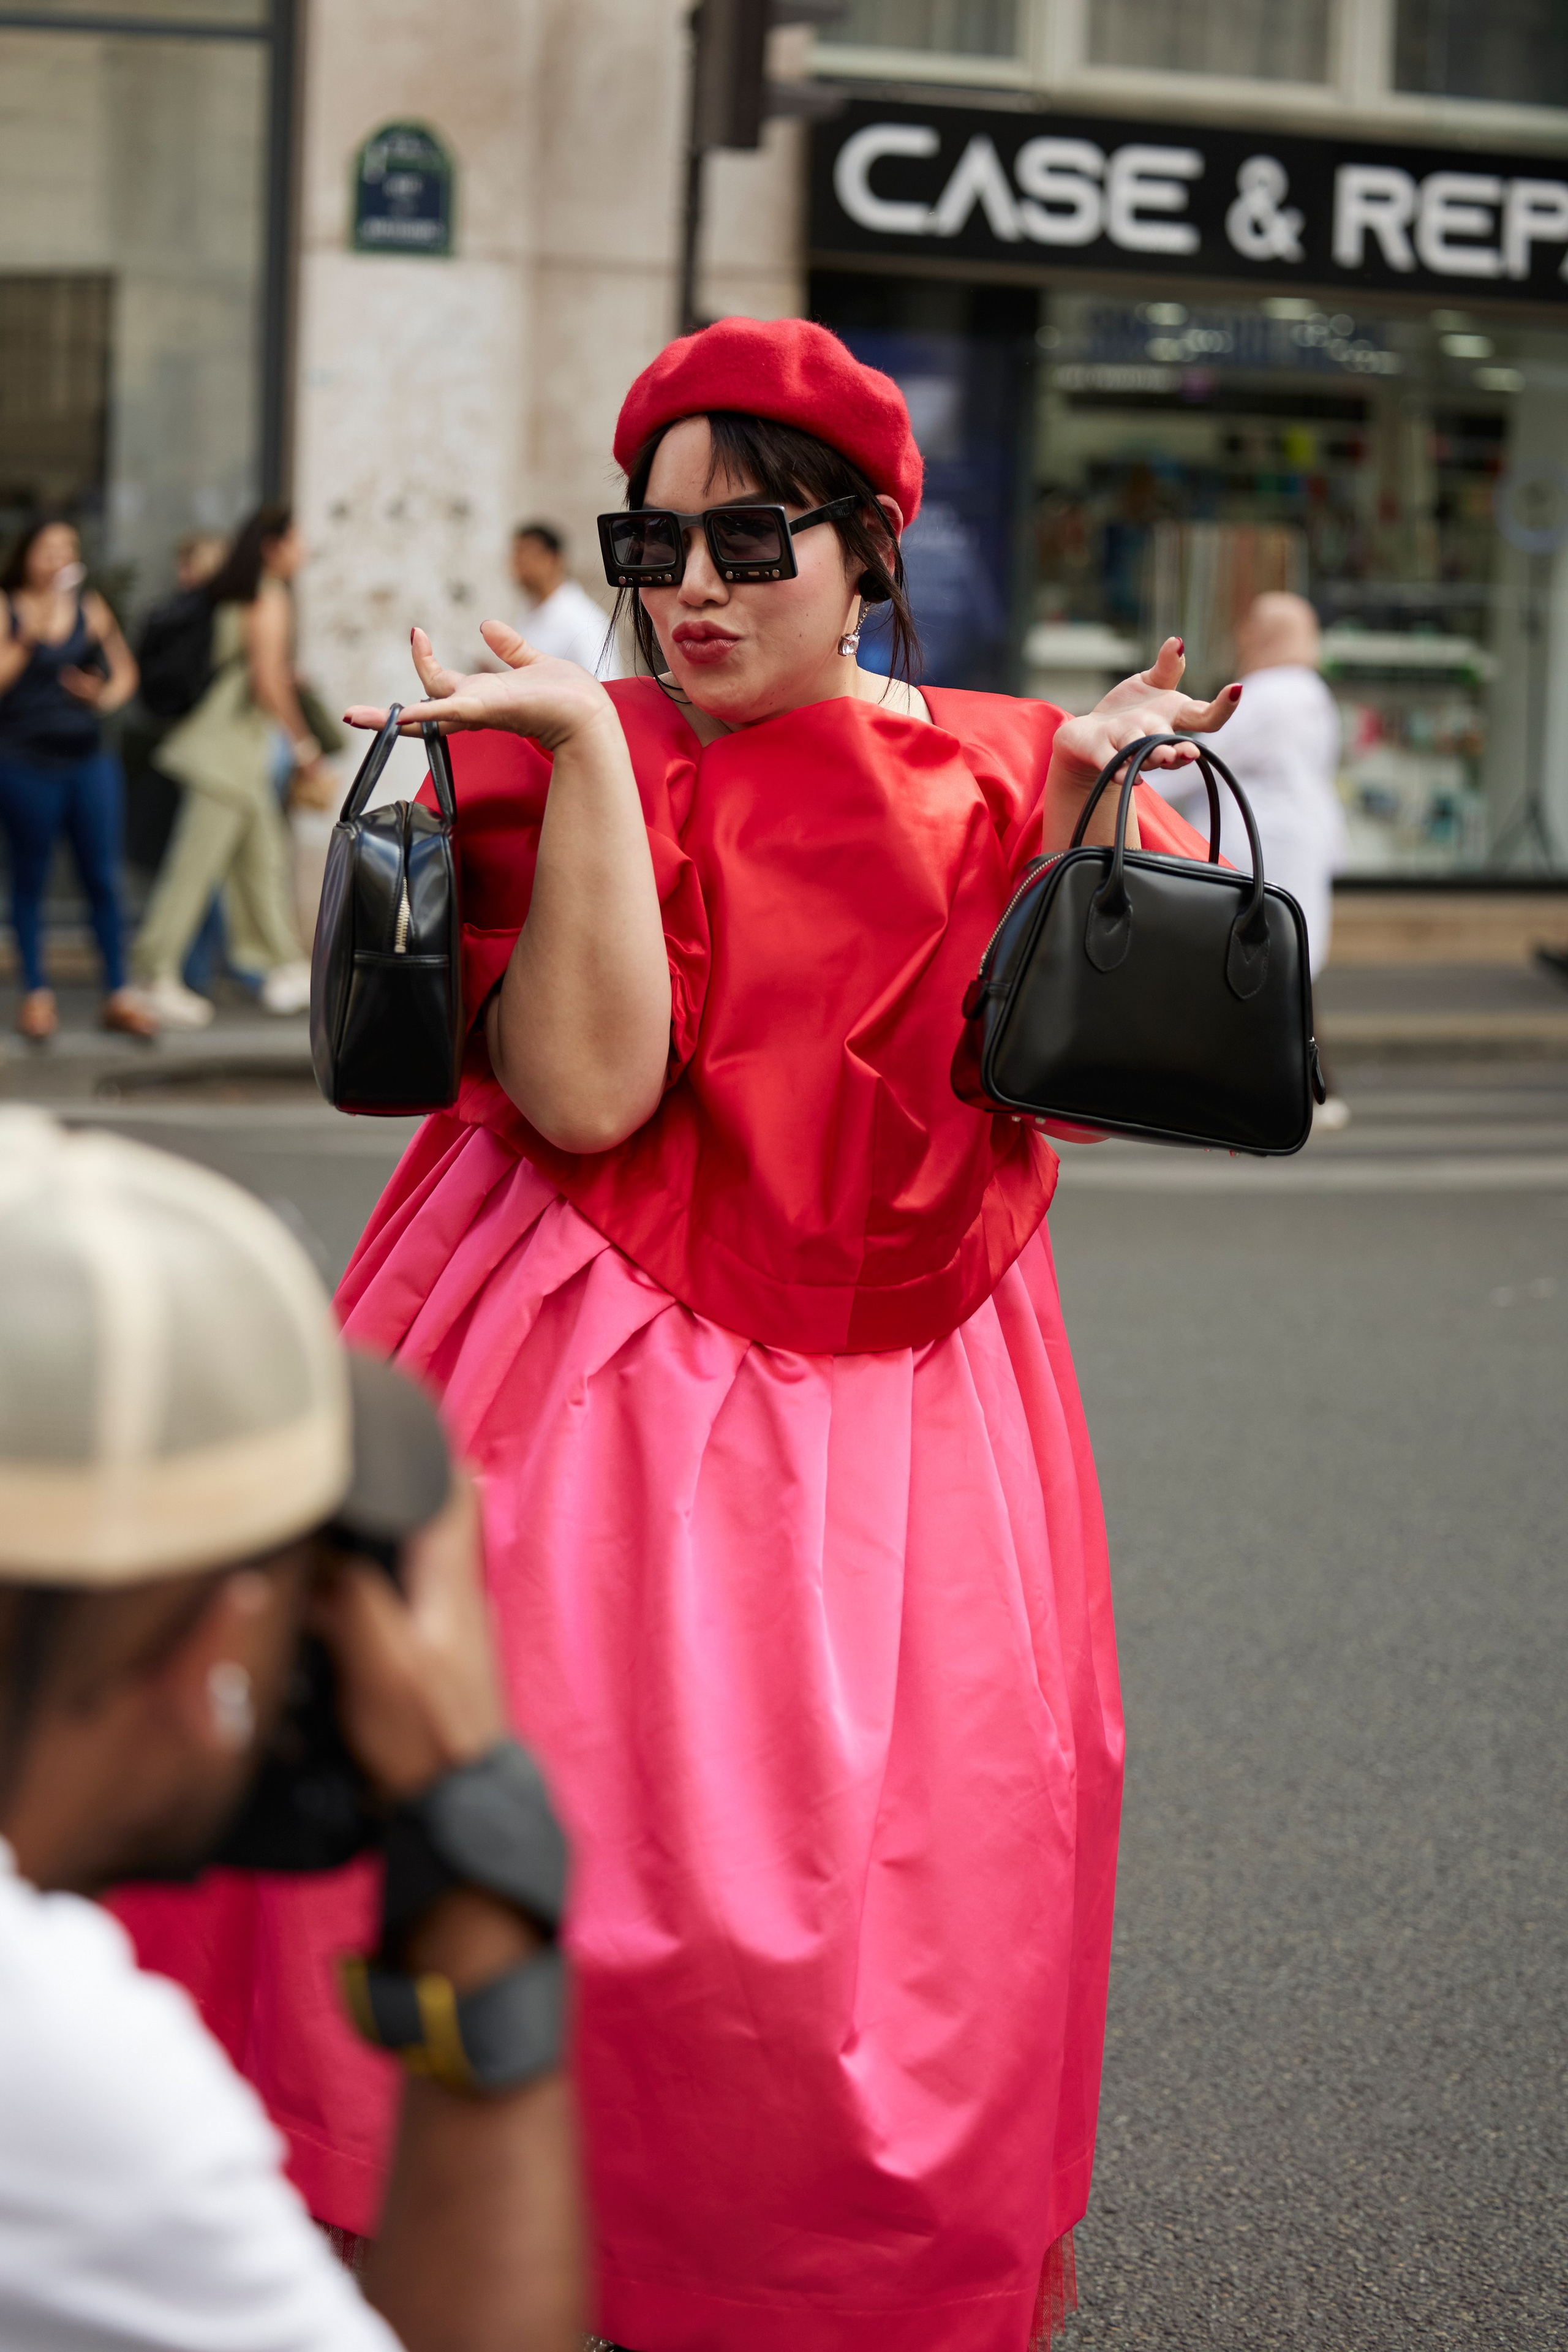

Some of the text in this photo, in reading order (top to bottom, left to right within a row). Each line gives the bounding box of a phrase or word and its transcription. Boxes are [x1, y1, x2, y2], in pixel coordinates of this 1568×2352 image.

[835, 124, 1568, 279] CASE & REP
